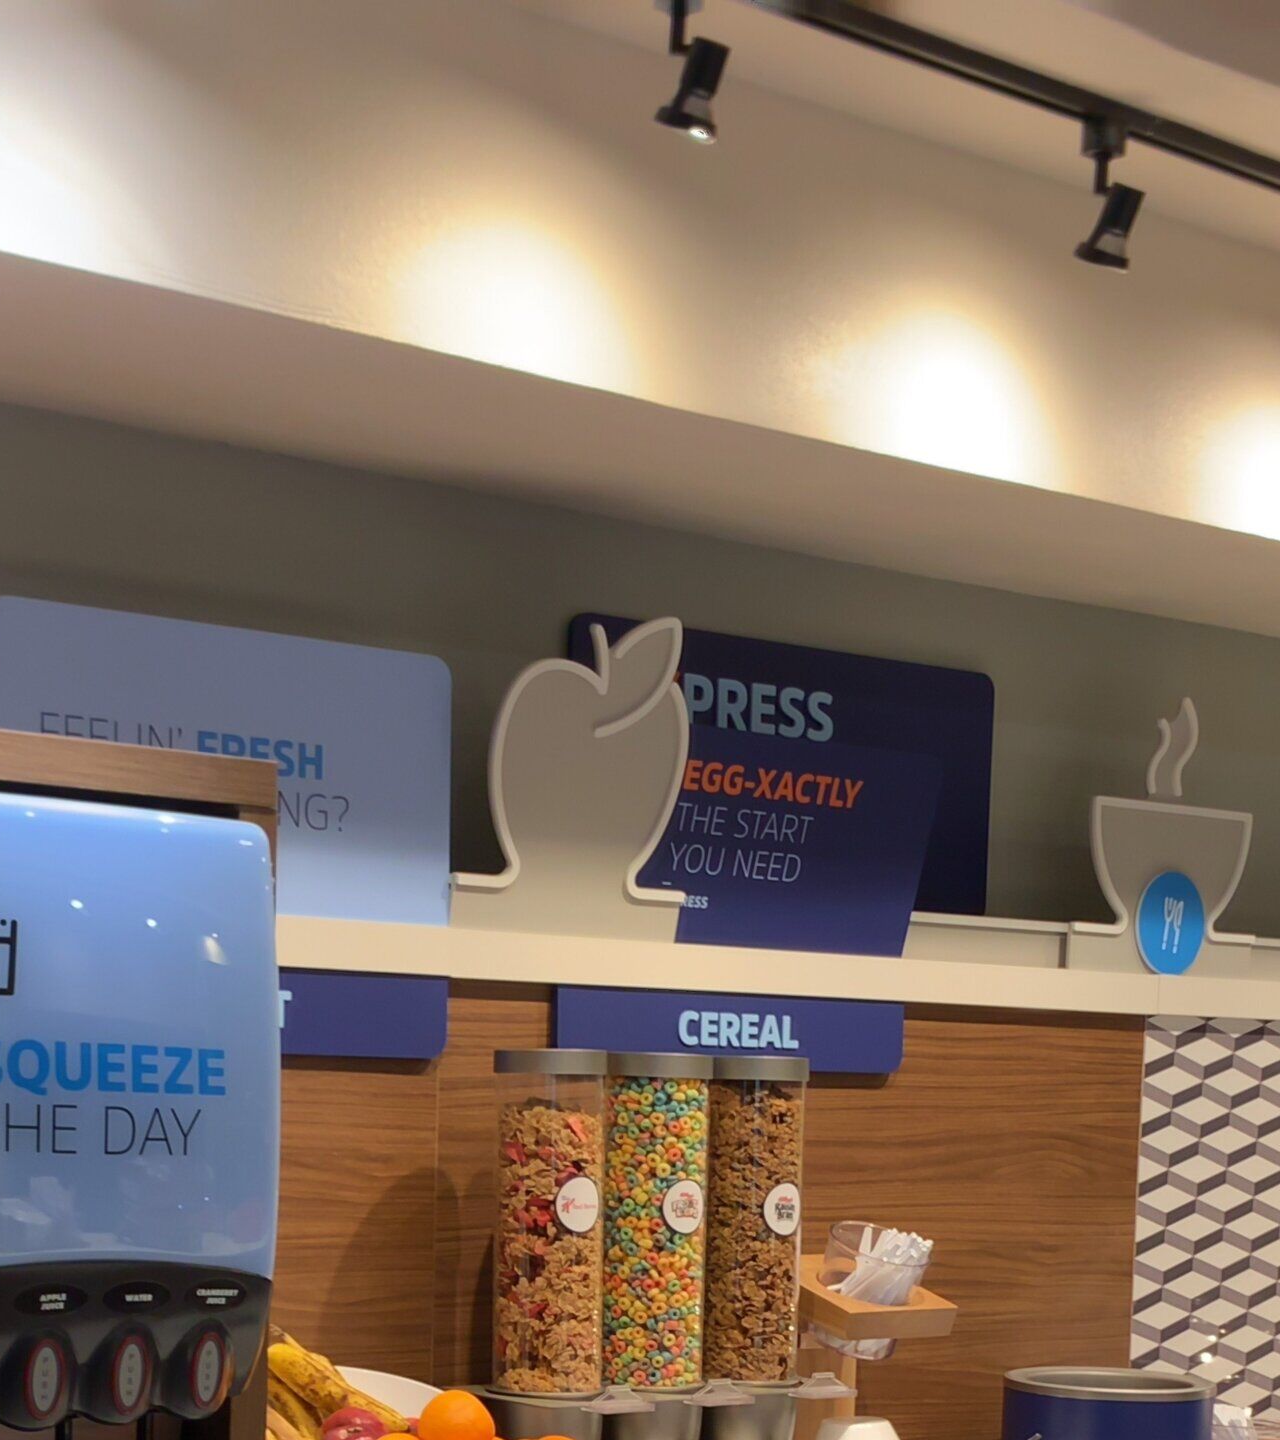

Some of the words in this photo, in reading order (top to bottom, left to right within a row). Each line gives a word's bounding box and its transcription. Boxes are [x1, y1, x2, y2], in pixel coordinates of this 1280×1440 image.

[683, 759, 865, 809] EGG-XACTLY
[677, 801, 729, 836] THE
[733, 808, 816, 845] START
[669, 841, 727, 877] YOU
[731, 848, 803, 883] NEED
[677, 1009, 800, 1050] CEREAL
[102, 1105, 202, 1157] DAY
[39, 1293, 67, 1302] APPLE
[124, 1293, 153, 1302] WATER
